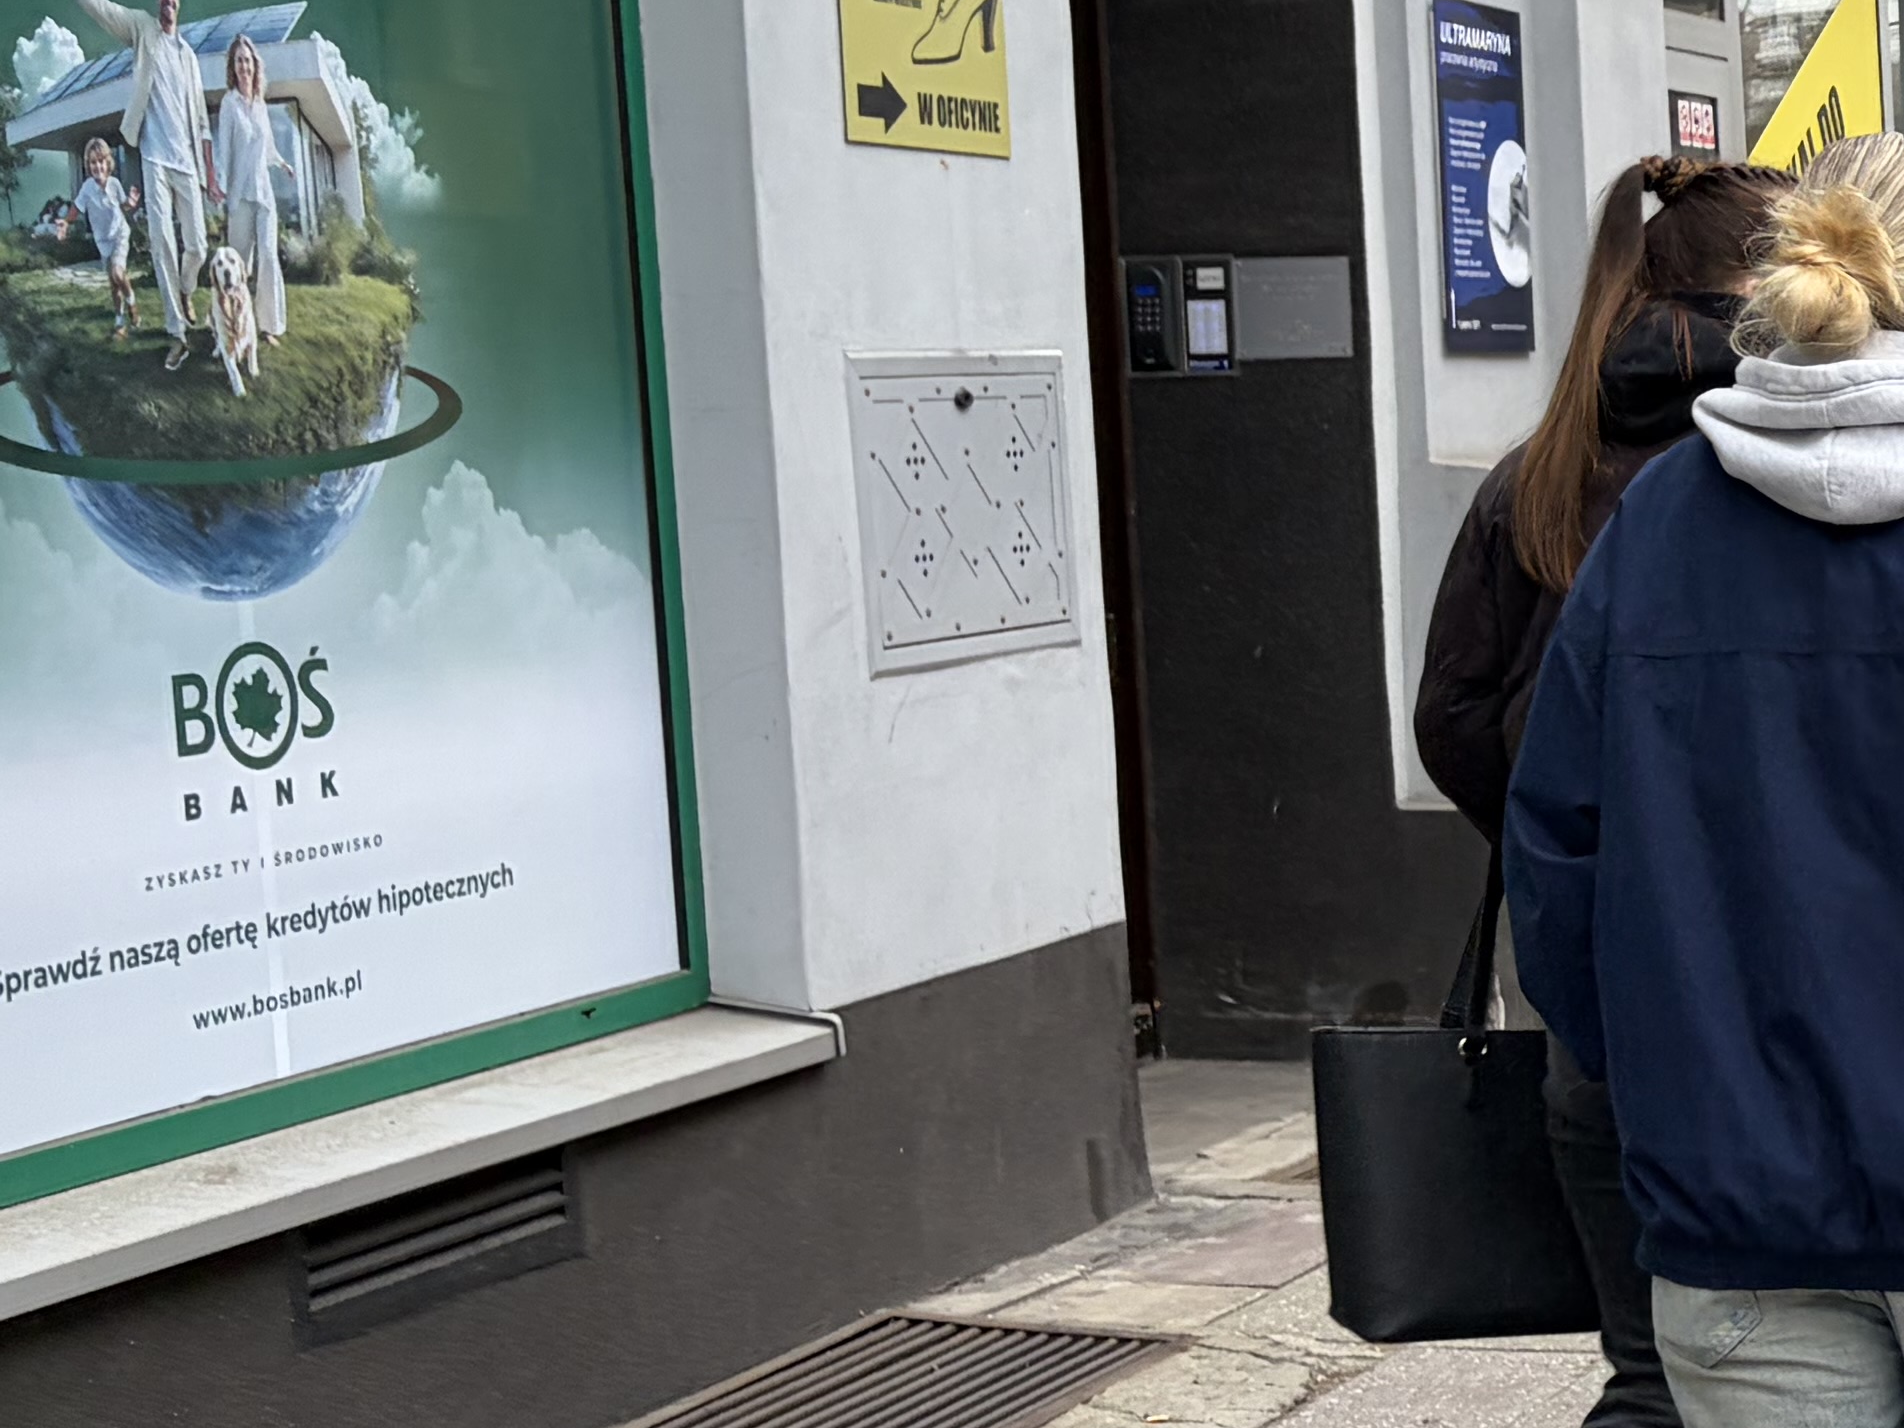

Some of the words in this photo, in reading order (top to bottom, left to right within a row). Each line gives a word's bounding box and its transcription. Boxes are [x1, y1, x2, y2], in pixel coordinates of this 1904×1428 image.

[1440, 20, 1511, 56] ULTRAMARYNA
[918, 92, 933, 126] W
[937, 94, 1001, 134] OFICYNIE
[172, 642, 335, 770] BOŚ
[184, 770, 340, 822] BANK
[144, 863, 223, 892] ZYSKASZ
[231, 857, 250, 877] TY
[273, 833, 385, 868] ŚRODOWISKO
[109, 935, 181, 974] naszą
[187, 914, 258, 958] ofertę
[266, 892, 373, 942] kredytów
[377, 861, 515, 921] hipotecznych
[193, 970, 363, 1031] www.bosbank.pl
